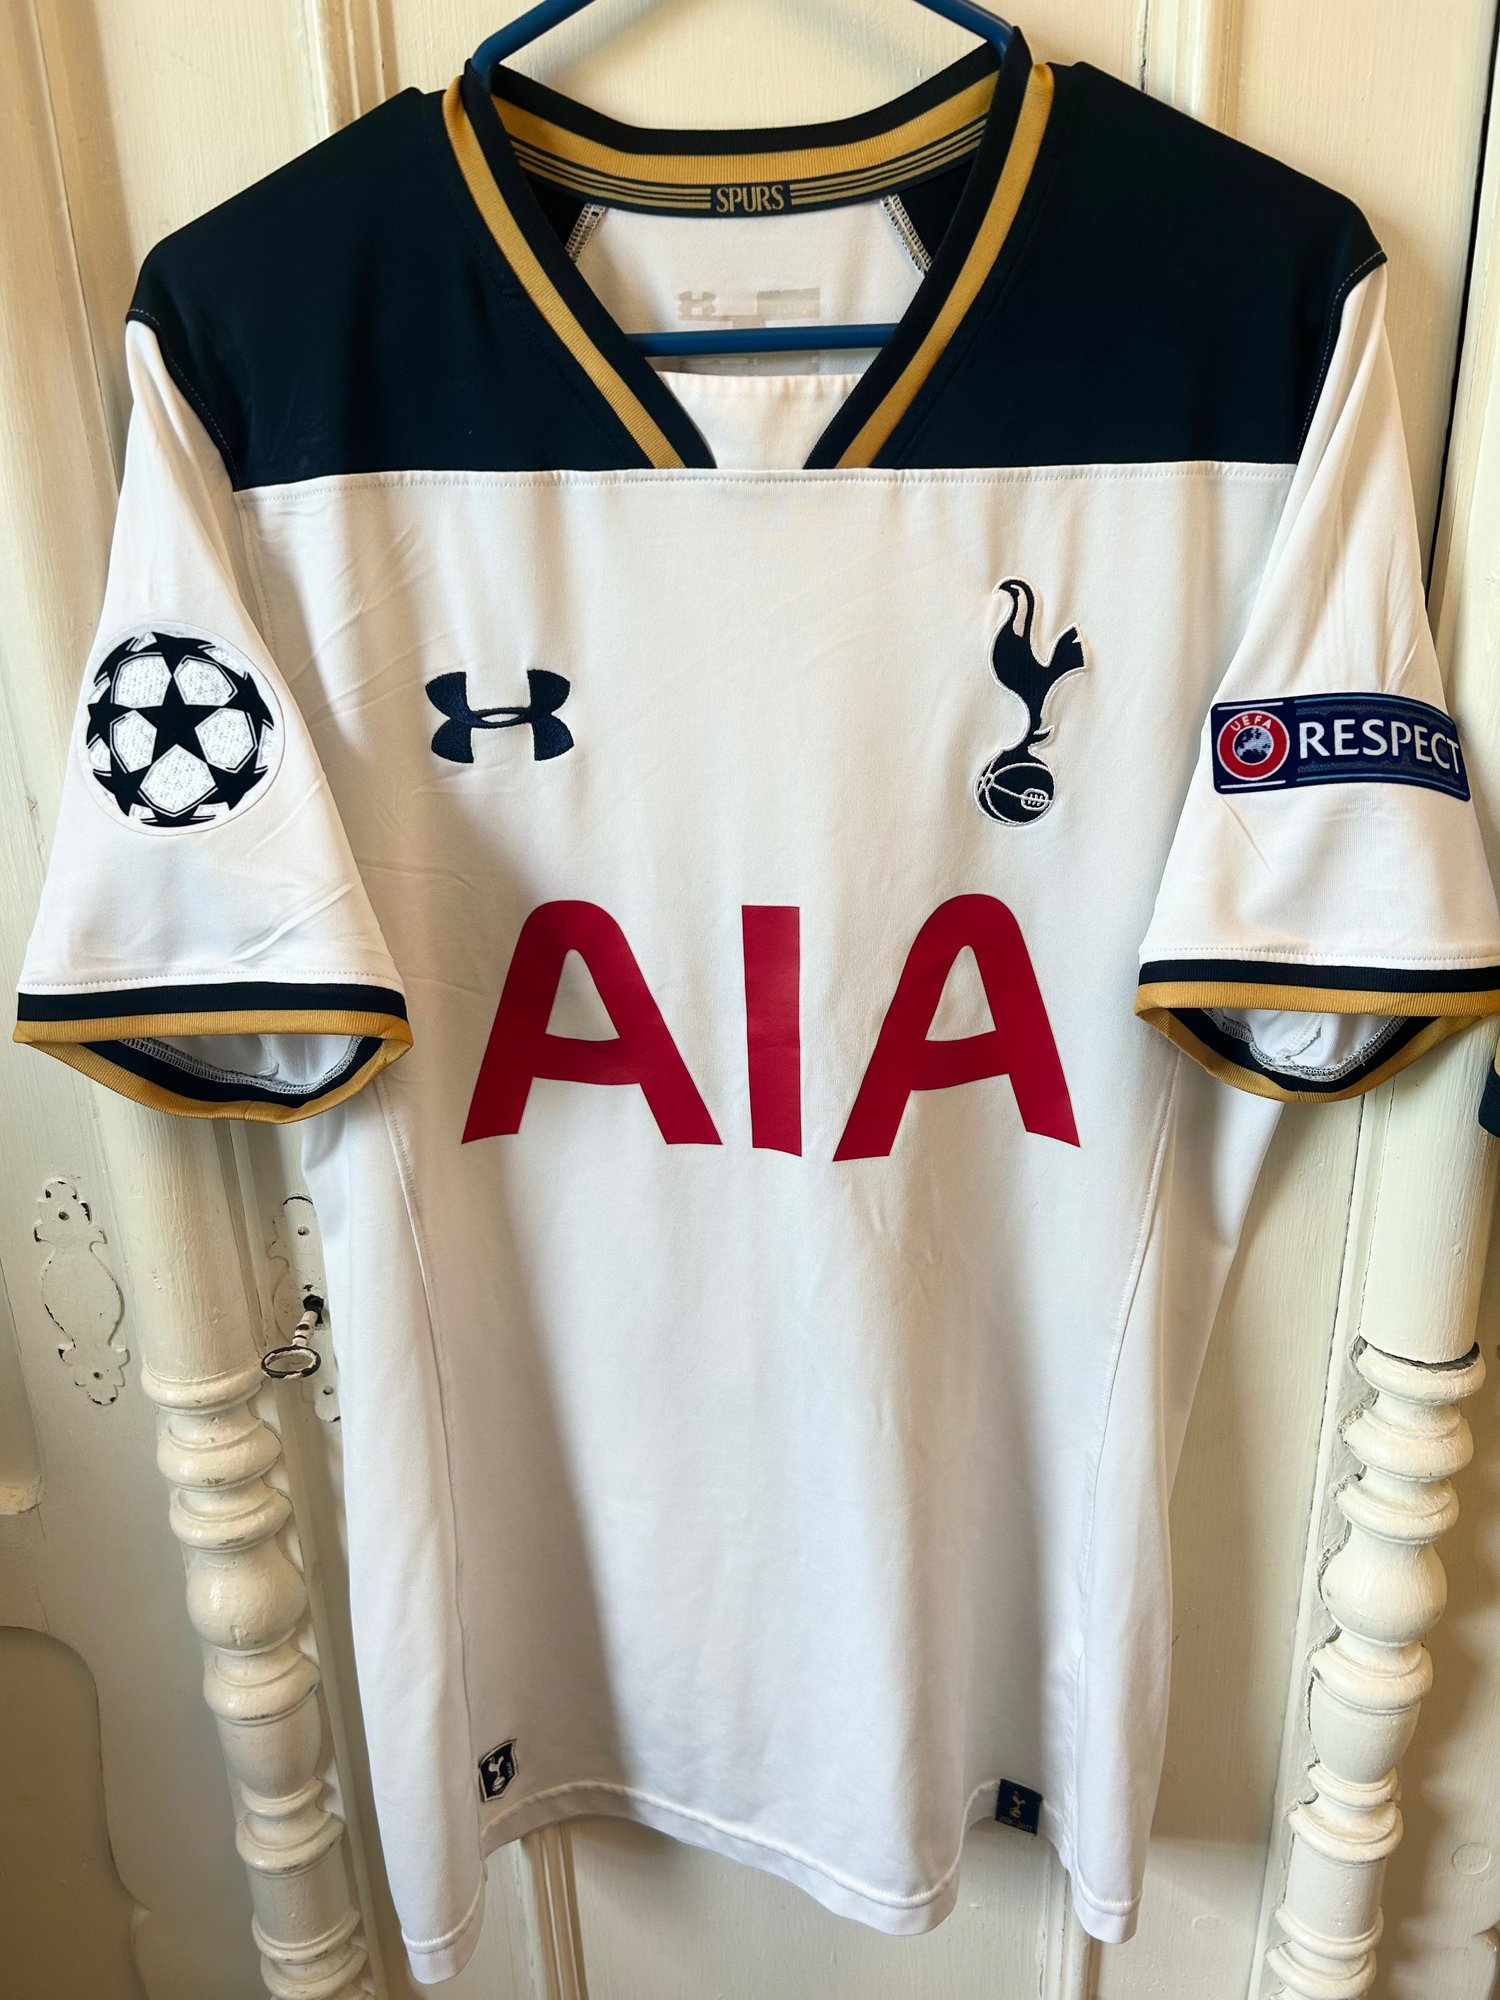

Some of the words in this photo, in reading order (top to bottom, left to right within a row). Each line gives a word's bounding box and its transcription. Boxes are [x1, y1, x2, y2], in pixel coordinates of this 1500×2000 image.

[716, 184, 785, 213] SPURS
[1230, 714, 1272, 732] UEFA
[1299, 718, 1460, 774] RESPECT
[461, 893, 1081, 1162] AIA
